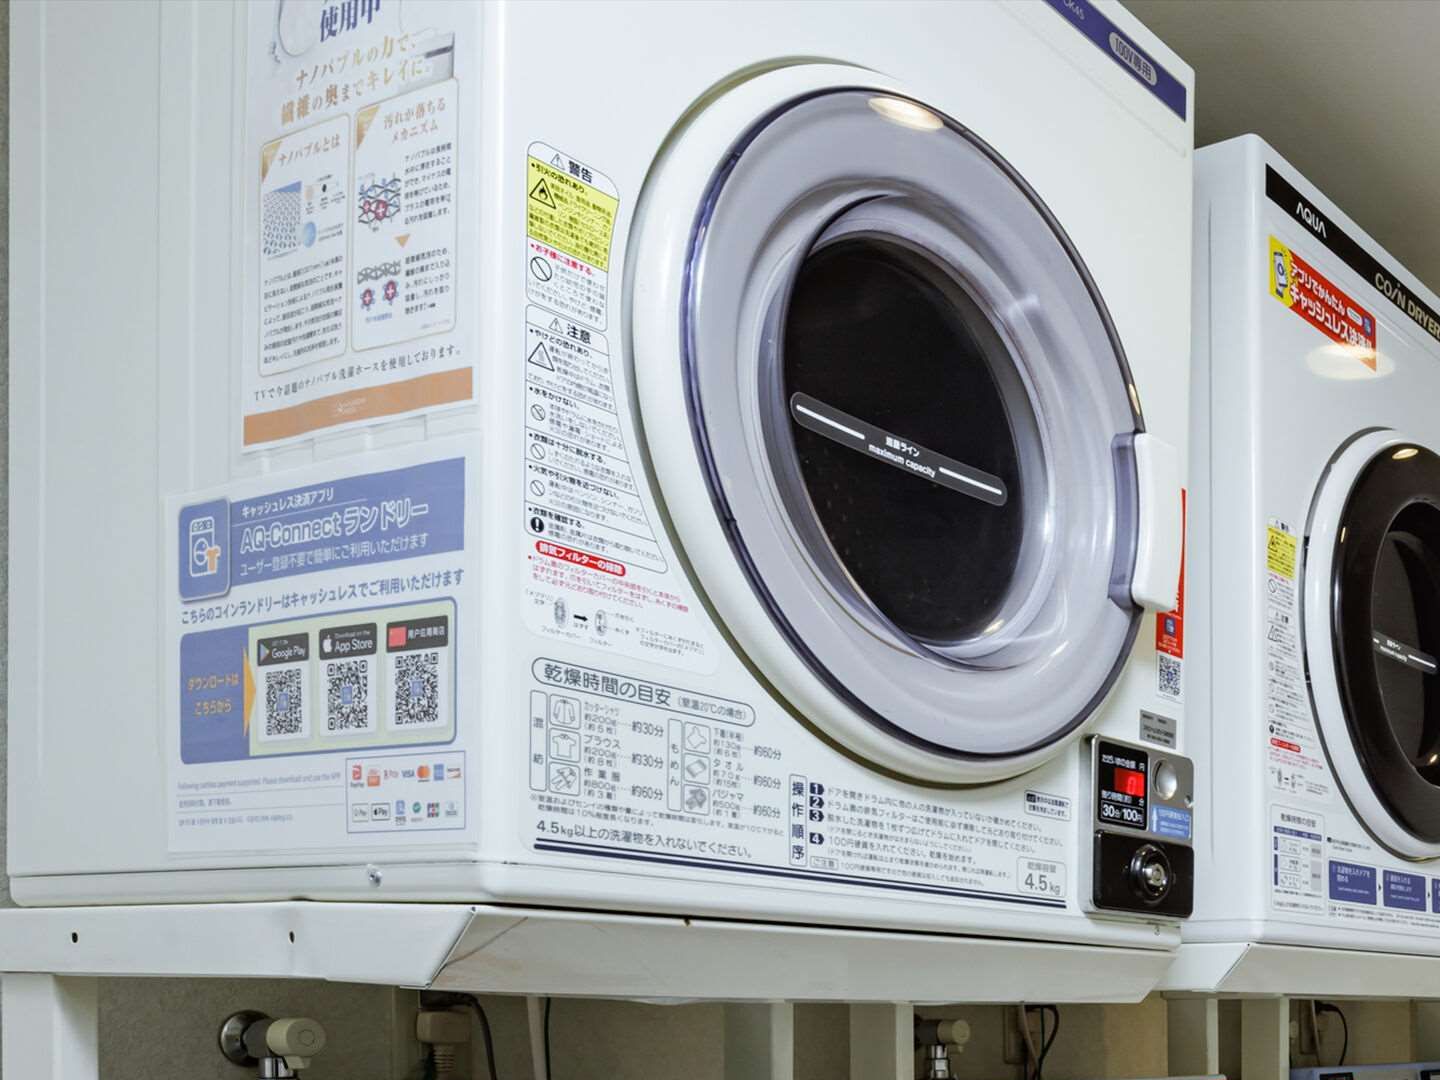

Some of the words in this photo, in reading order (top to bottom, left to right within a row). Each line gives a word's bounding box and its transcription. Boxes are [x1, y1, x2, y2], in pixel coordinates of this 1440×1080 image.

[568, 160, 593, 184] 警告
[1296, 202, 1327, 238] AQUA
[1375, 272, 1406, 308] COIN
[1407, 299, 1440, 339] DRYER
[567, 322, 591, 344] 注意
[242, 487, 334, 518] キャッシュレス決済アプリ
[344, 498, 429, 536] ランドリー
[240, 532, 429, 576] ユーザー登録不要で簡単にご利用いただけます
[182, 569, 465, 625] こちらのコインランドリーはキャッシュレスでご利用いただけます
[335, 642, 350, 654] App
[351, 638, 374, 651] Store
[187, 672, 239, 692] ダウンロードは
[544, 663, 671, 707] 乾燥時間の目安
[631, 720, 664, 737] 約30分
[584, 734, 621, 749] ブラウス
[631, 753, 664, 769] 約30分
[631, 785, 664, 801] 約60分
